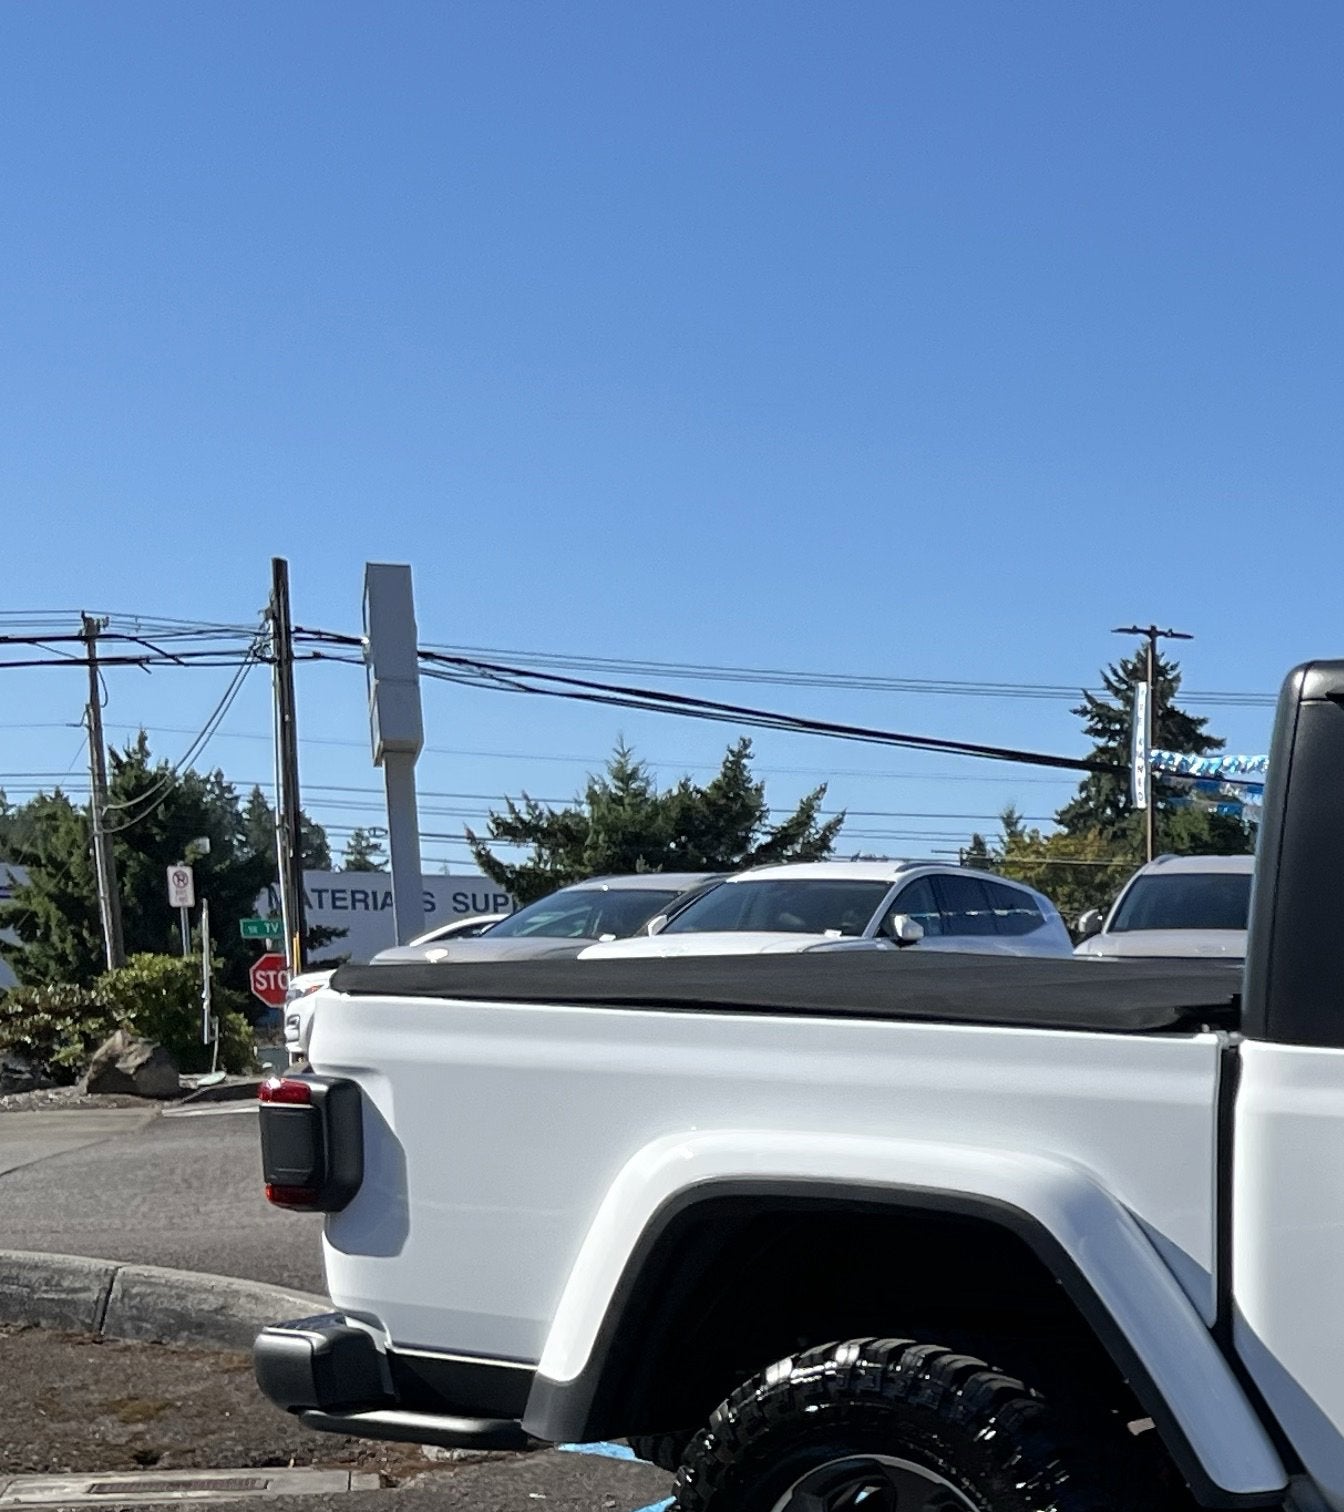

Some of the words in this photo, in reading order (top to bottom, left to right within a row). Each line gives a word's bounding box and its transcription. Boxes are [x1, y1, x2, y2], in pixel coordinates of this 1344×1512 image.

[268, 884, 436, 912] MATERIAS
[264, 922, 279, 933] TV
[255, 971, 288, 990] STO
